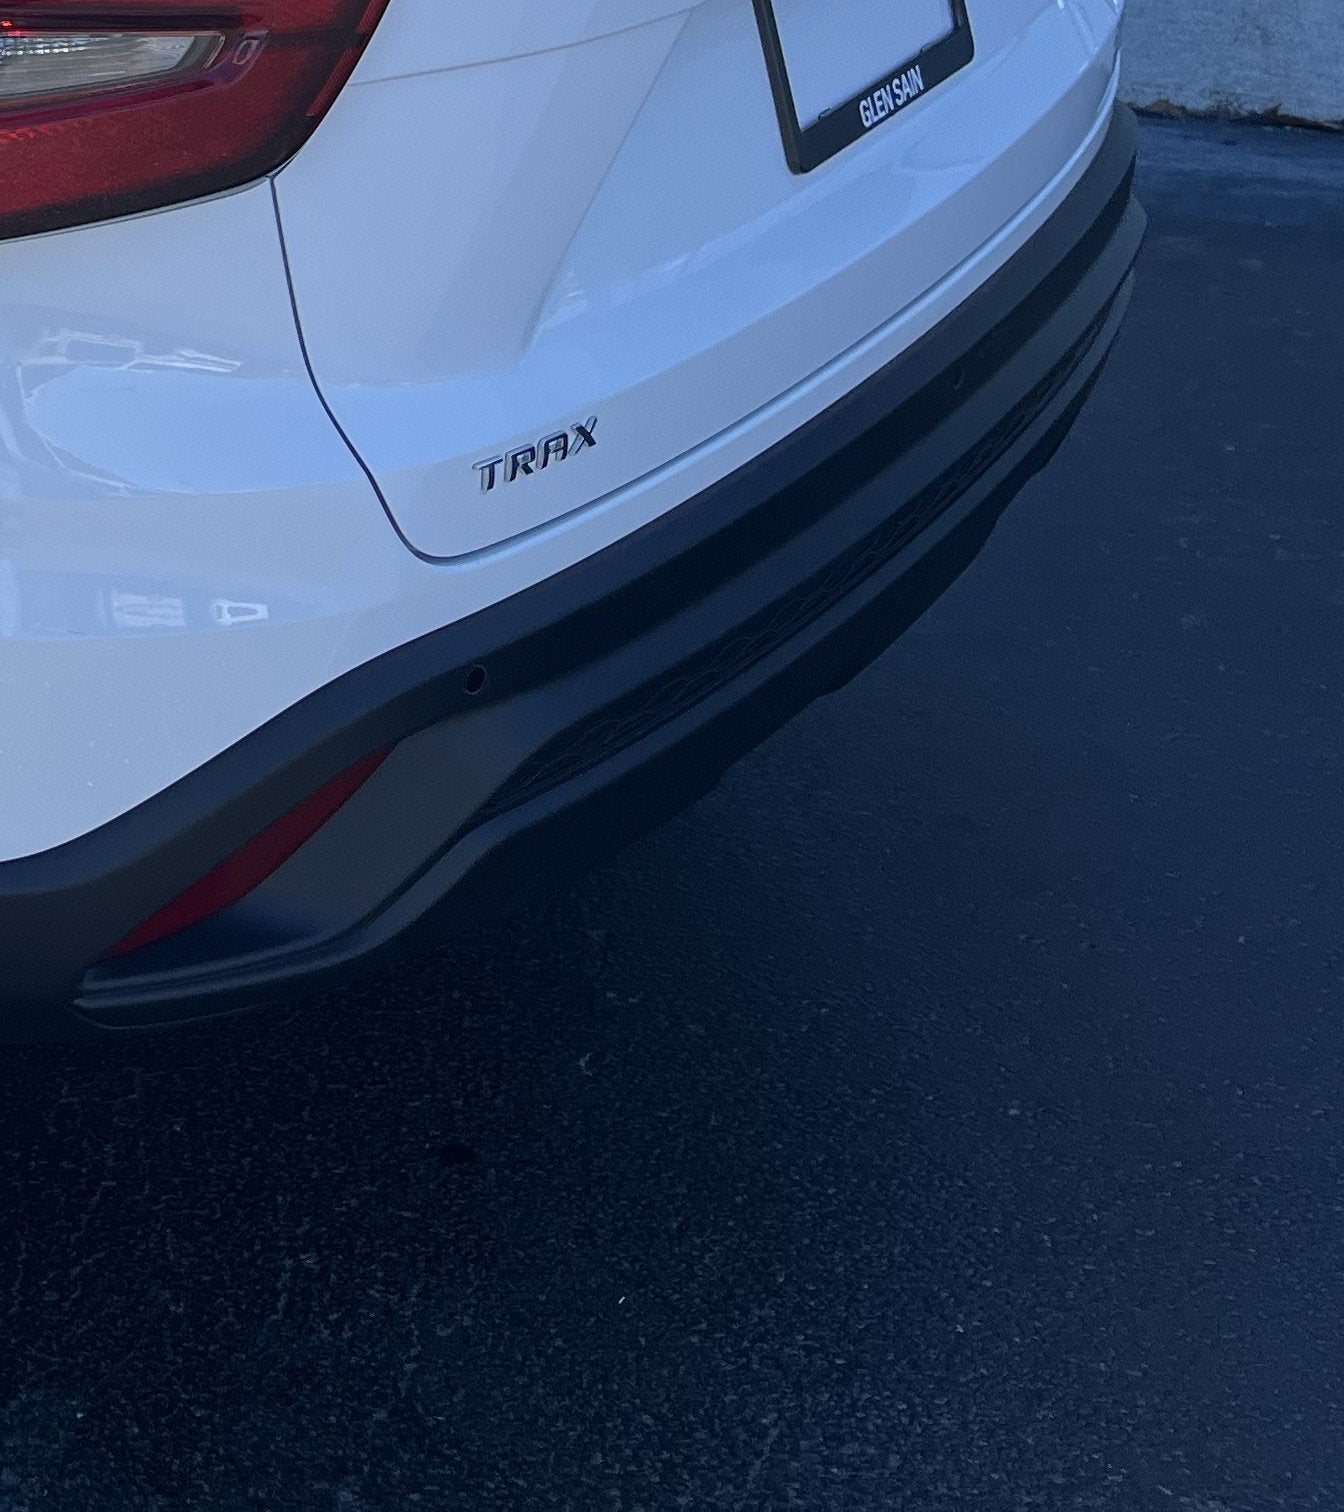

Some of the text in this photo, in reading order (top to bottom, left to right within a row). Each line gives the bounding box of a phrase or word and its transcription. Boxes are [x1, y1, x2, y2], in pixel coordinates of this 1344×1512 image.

[859, 64, 925, 128] GLEN SAIN
[471, 415, 599, 495] TRAX
